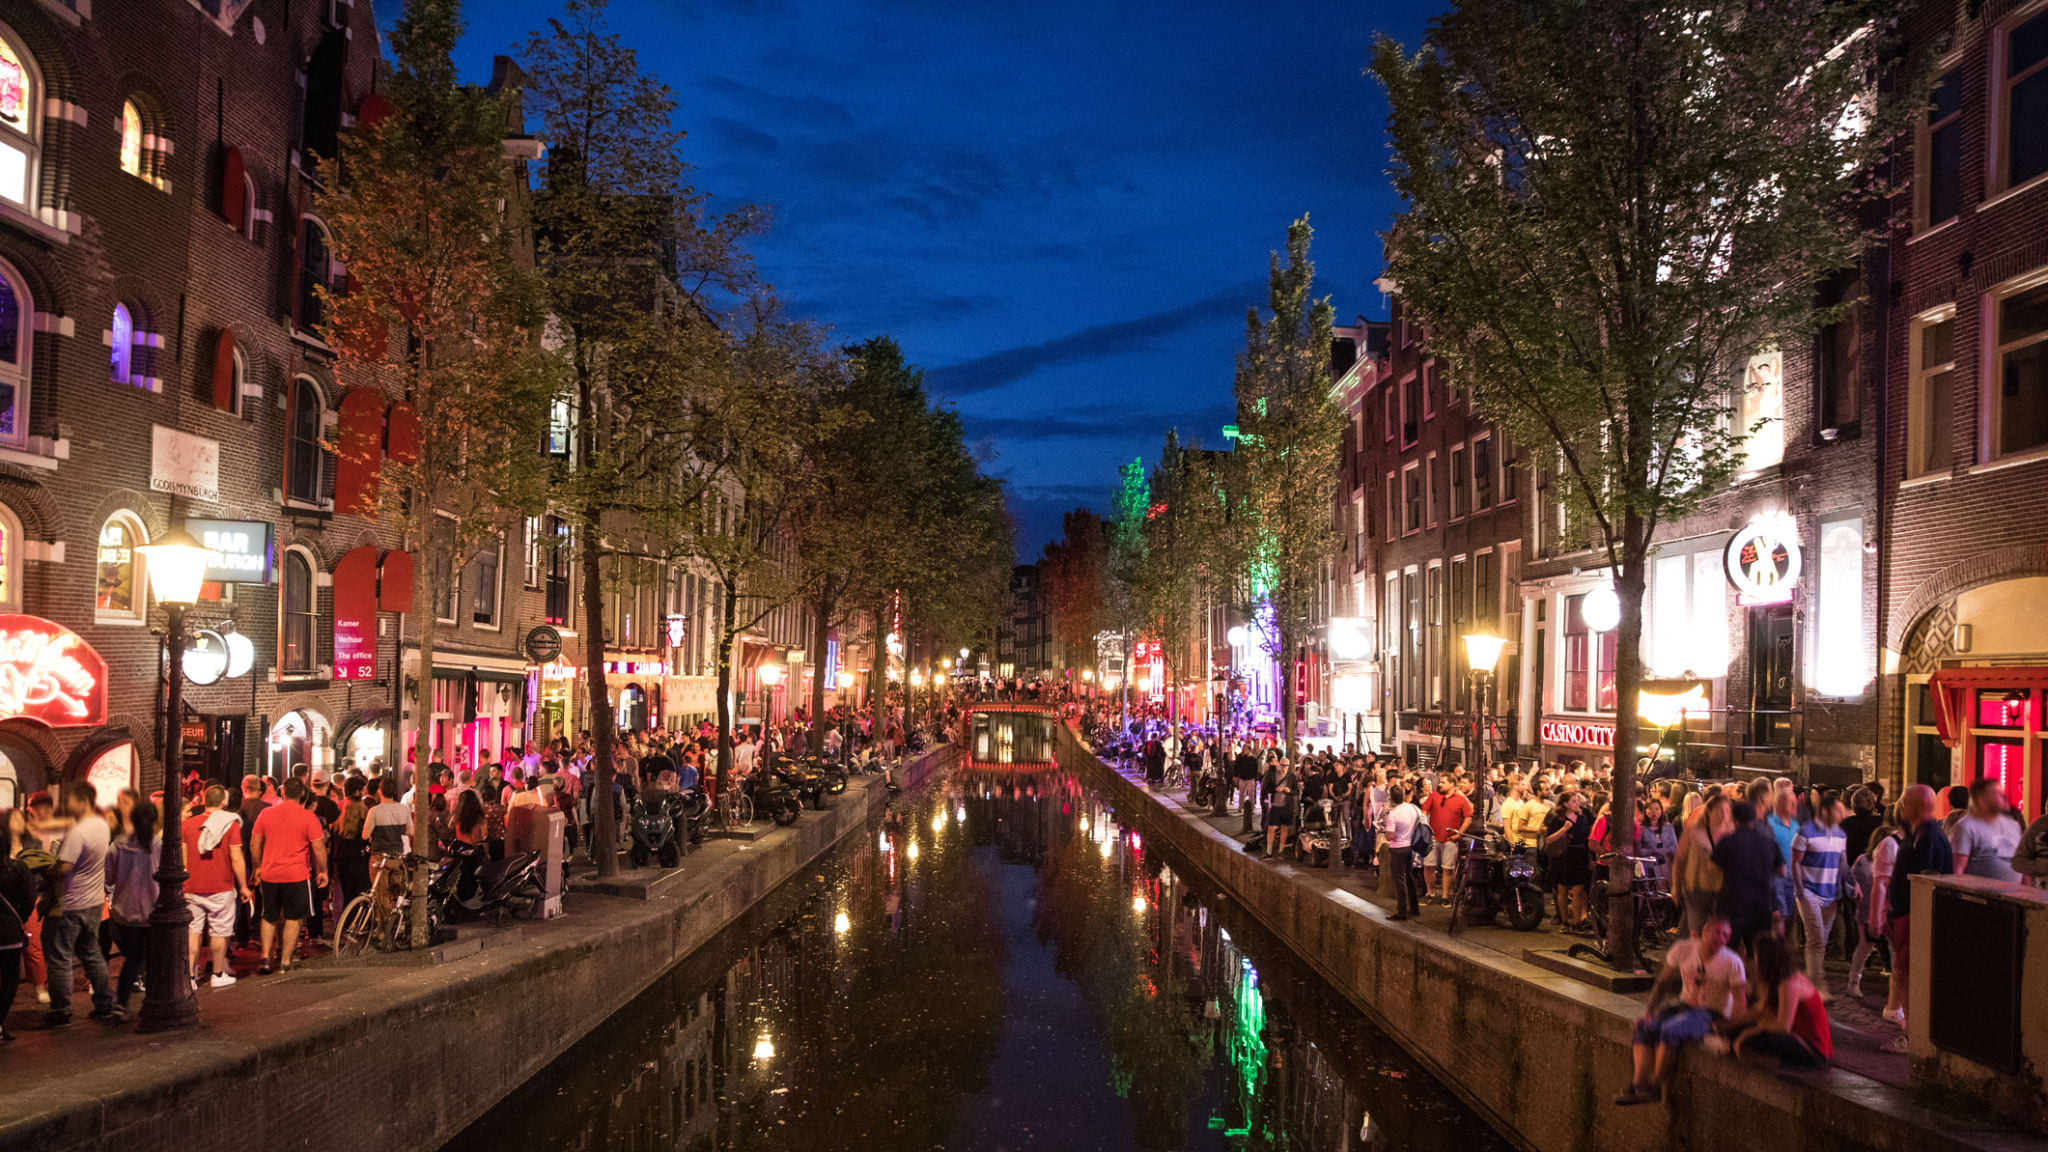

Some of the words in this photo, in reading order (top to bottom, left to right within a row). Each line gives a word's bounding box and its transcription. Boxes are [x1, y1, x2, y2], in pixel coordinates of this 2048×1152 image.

[204, 531, 248, 553] BAR
[337, 620, 360, 628] Kamer
[338, 635, 363, 644] Verhuur
[338, 651, 350, 660] The
[352, 651, 372, 660] office
[358, 666, 372, 678] 52
[181, 726, 204, 738] SEUM
[1541, 722, 1584, 744] CASINO
[1585, 726, 1616, 747] CITY
